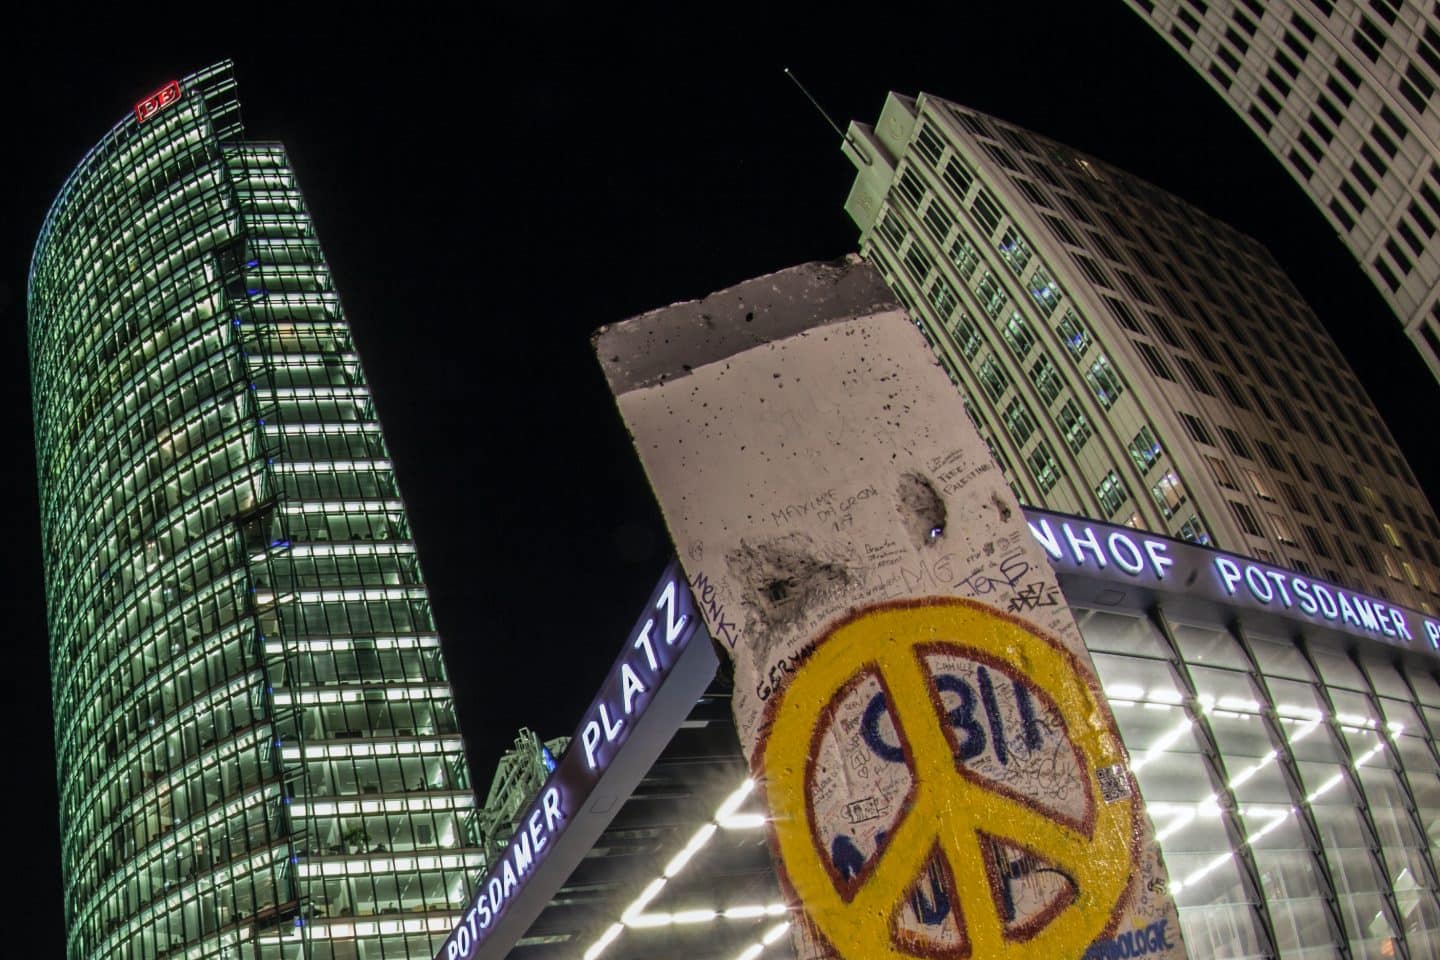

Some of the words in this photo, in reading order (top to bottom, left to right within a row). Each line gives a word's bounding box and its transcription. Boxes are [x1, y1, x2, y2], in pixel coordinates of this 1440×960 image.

[1215, 557, 1412, 641] POTSDAMER
[1423, 620, 1440, 650] P
[581, 581, 688, 768] PLATZ
